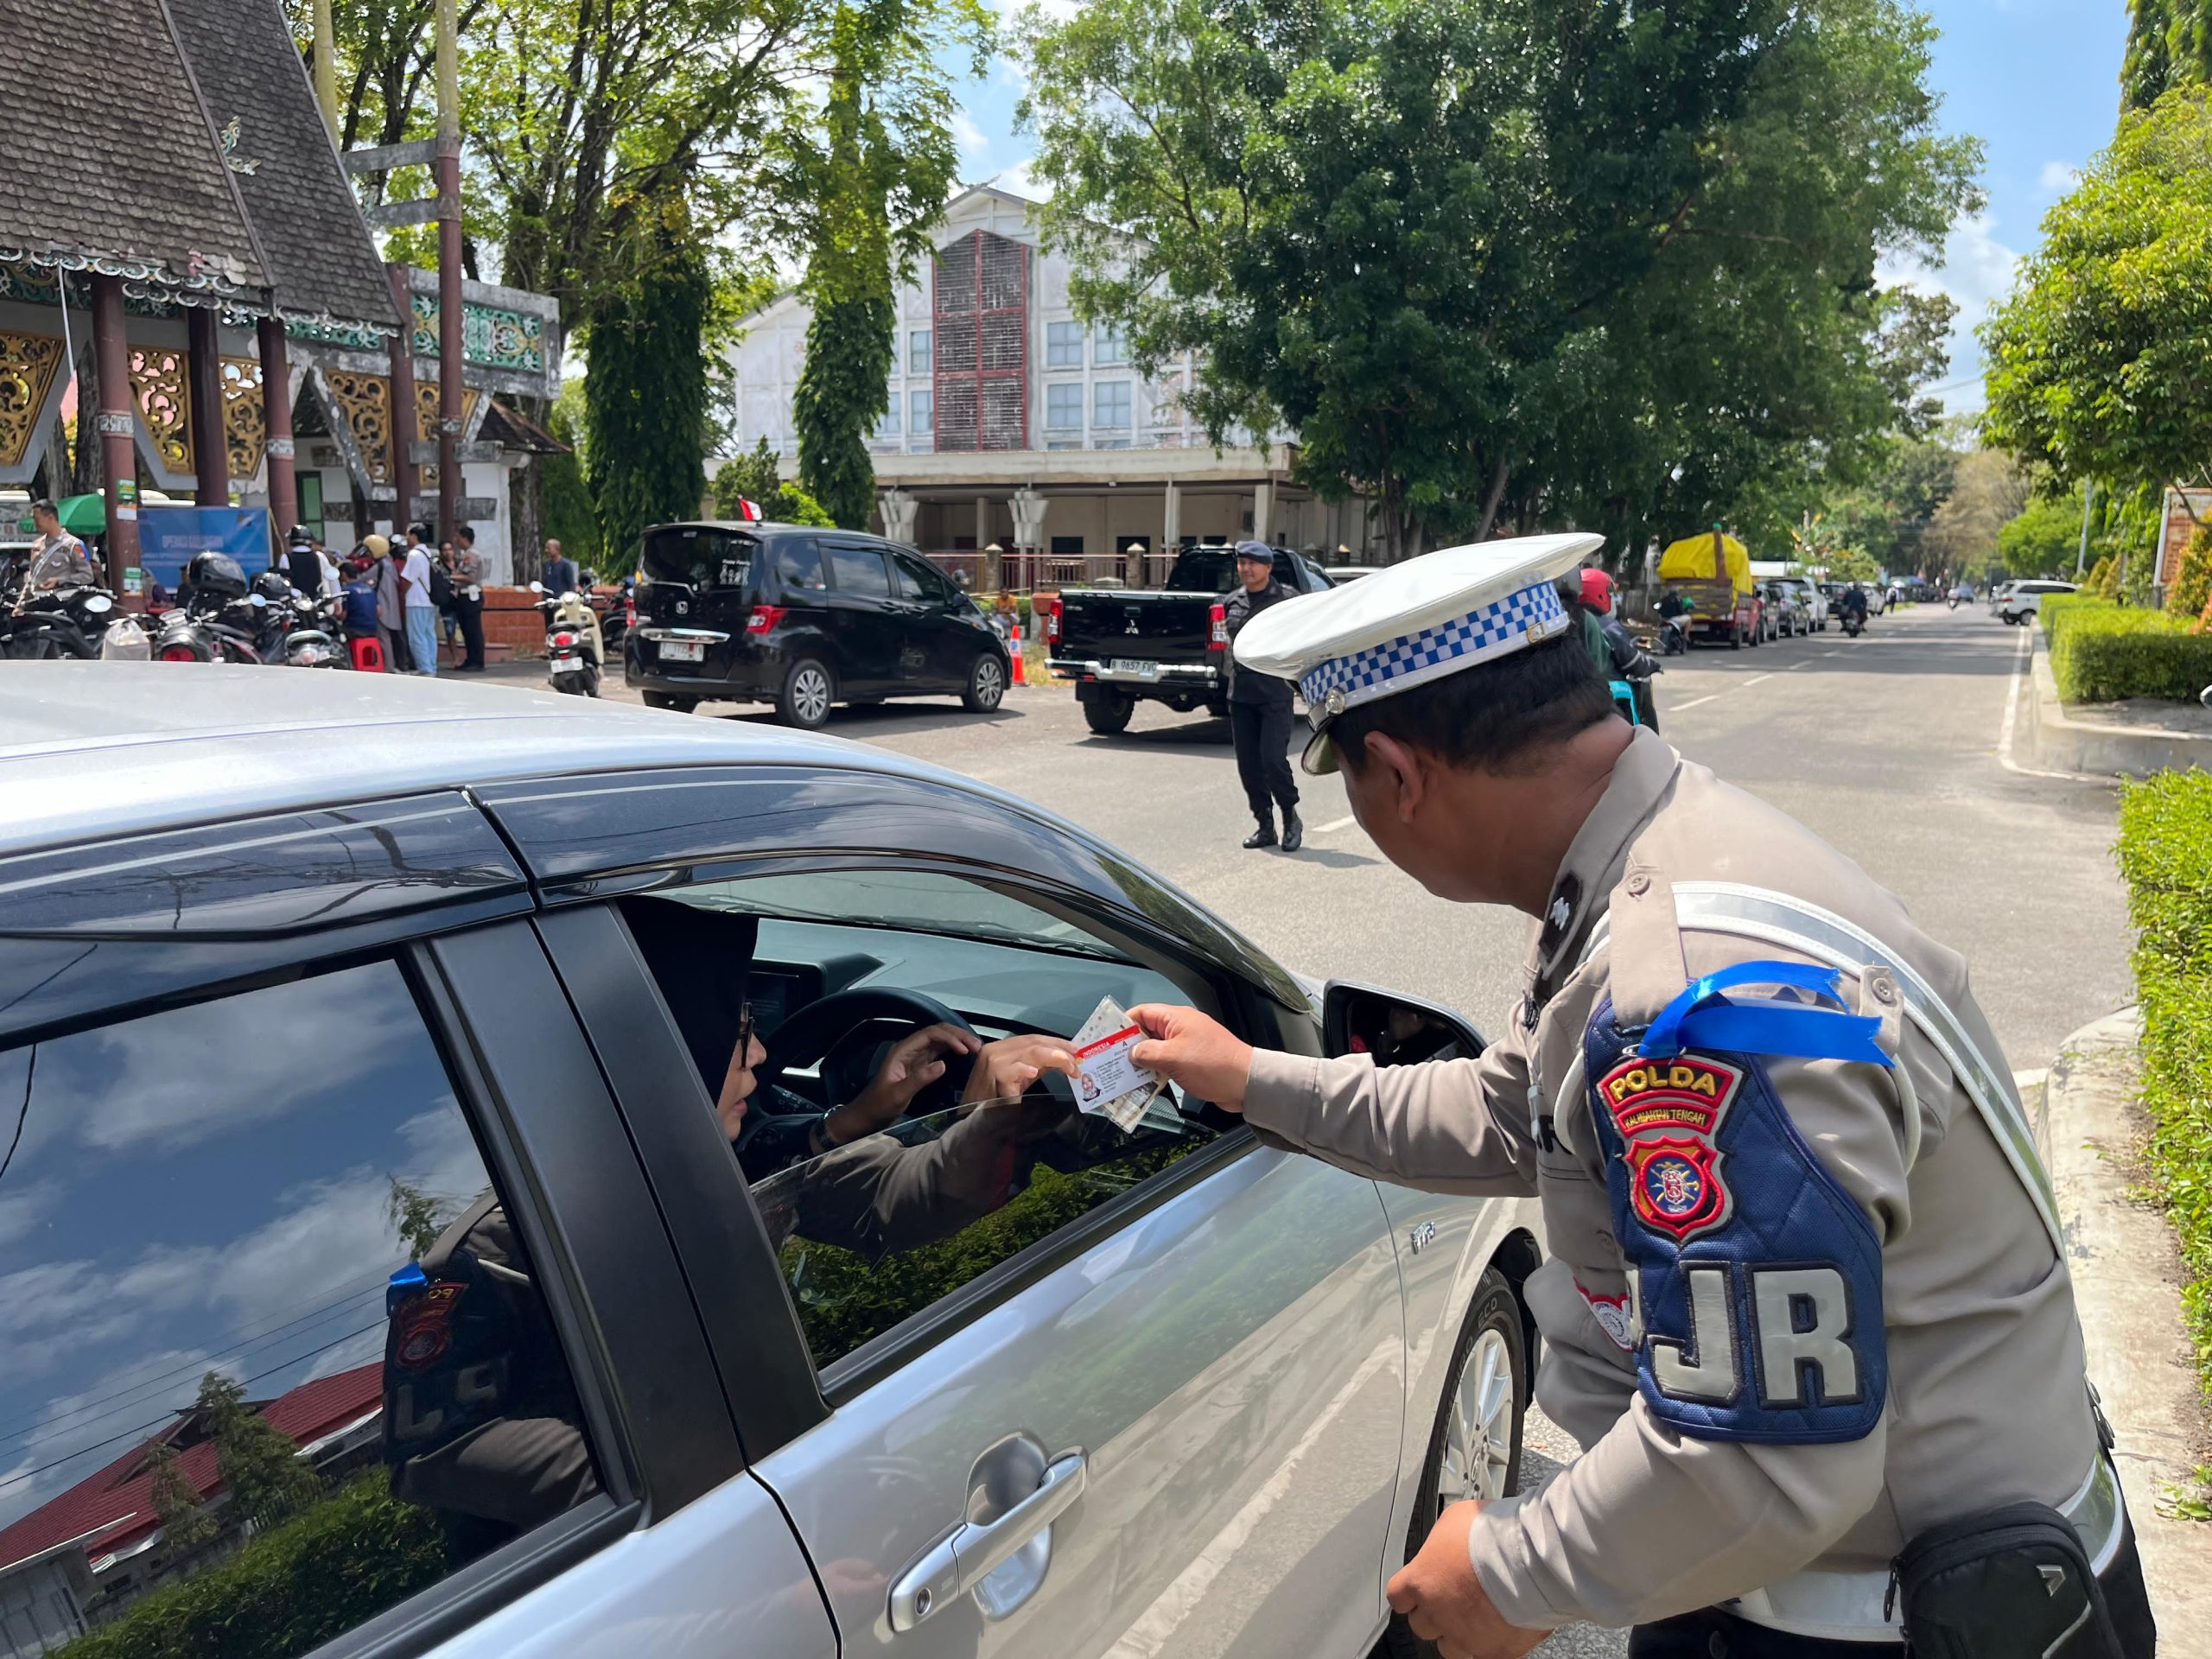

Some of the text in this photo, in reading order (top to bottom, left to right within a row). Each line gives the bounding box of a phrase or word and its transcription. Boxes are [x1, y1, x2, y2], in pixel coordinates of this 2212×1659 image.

[1111, 660, 1116, 669] B
[1082, 1041, 1110, 1058] INDONESIA
[1609, 1065, 1717, 1102] POLDA
[1670, 1109, 1707, 1126] TENGAH
[1478, 1297, 1497, 1328] ECO
[1627, 1263, 1862, 1406] JR
